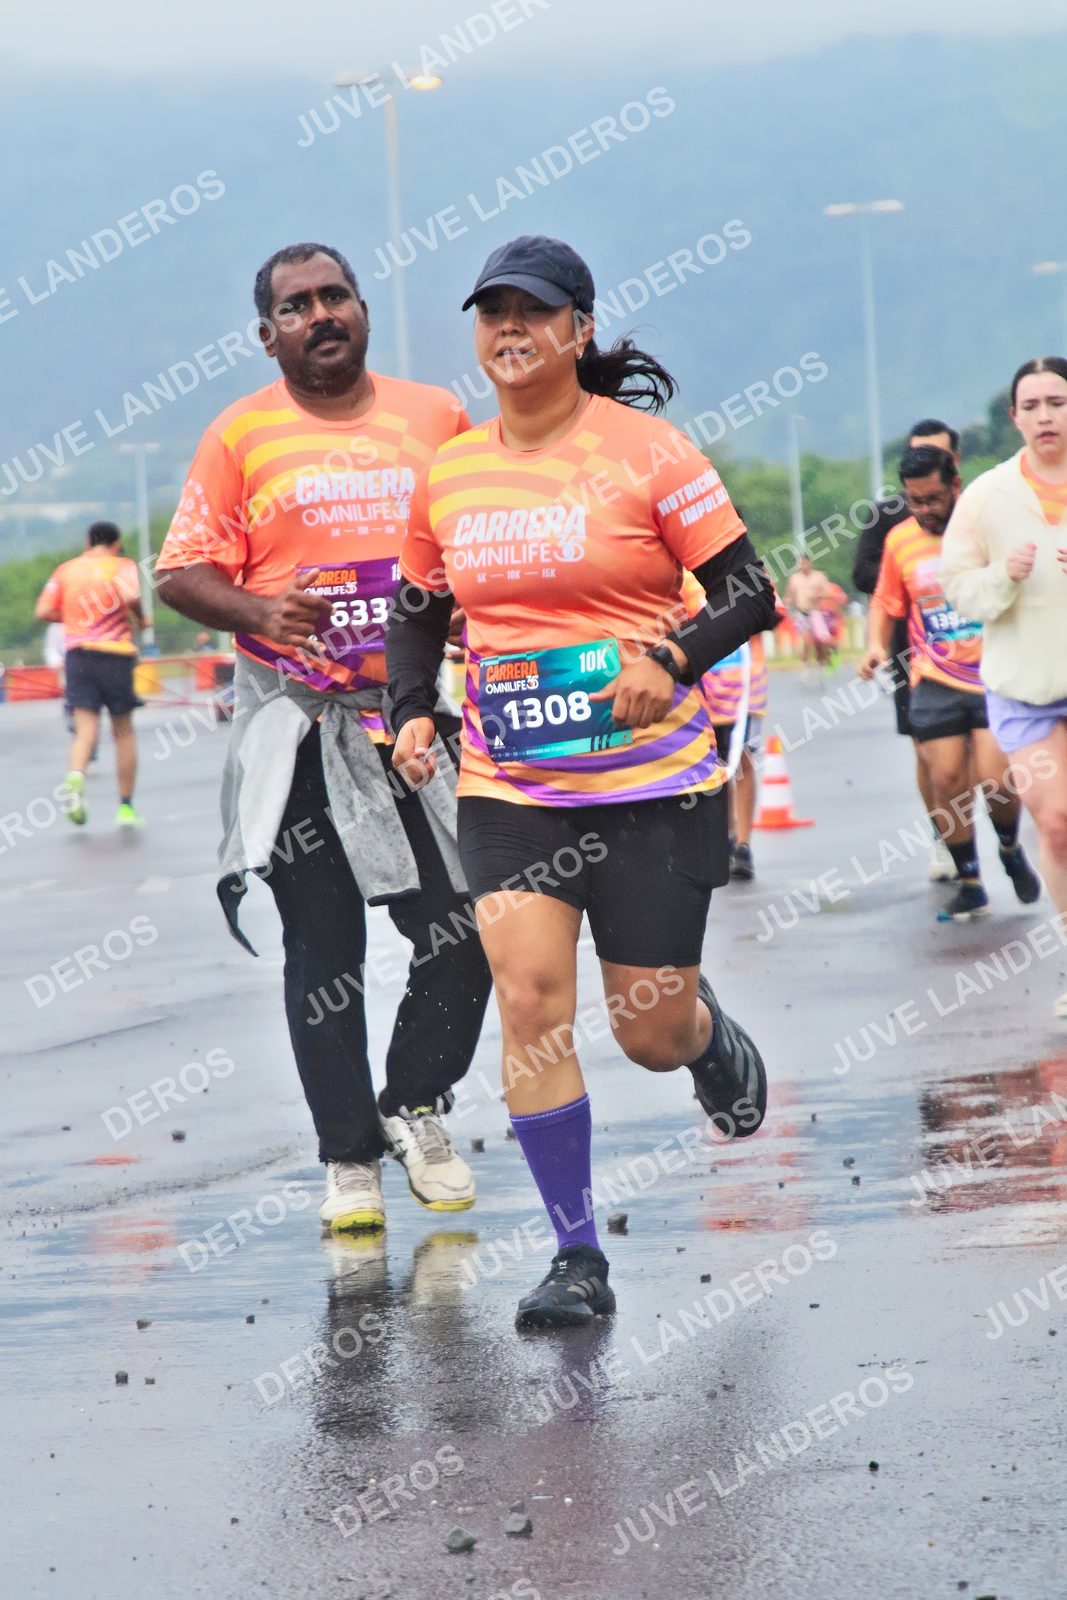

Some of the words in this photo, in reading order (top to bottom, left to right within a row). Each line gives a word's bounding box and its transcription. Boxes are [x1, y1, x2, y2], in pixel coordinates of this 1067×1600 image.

[296, 467, 416, 505] CARRERA
[302, 502, 391, 526] OMNILIFE
[453, 505, 586, 546] CARRERA
[453, 543, 551, 570] OMNILIFE
[486, 661, 538, 682] CARRERA
[579, 650, 607, 673] 10K
[486, 680, 526, 694] OMNILIFE
[503, 691, 592, 730] 1308
